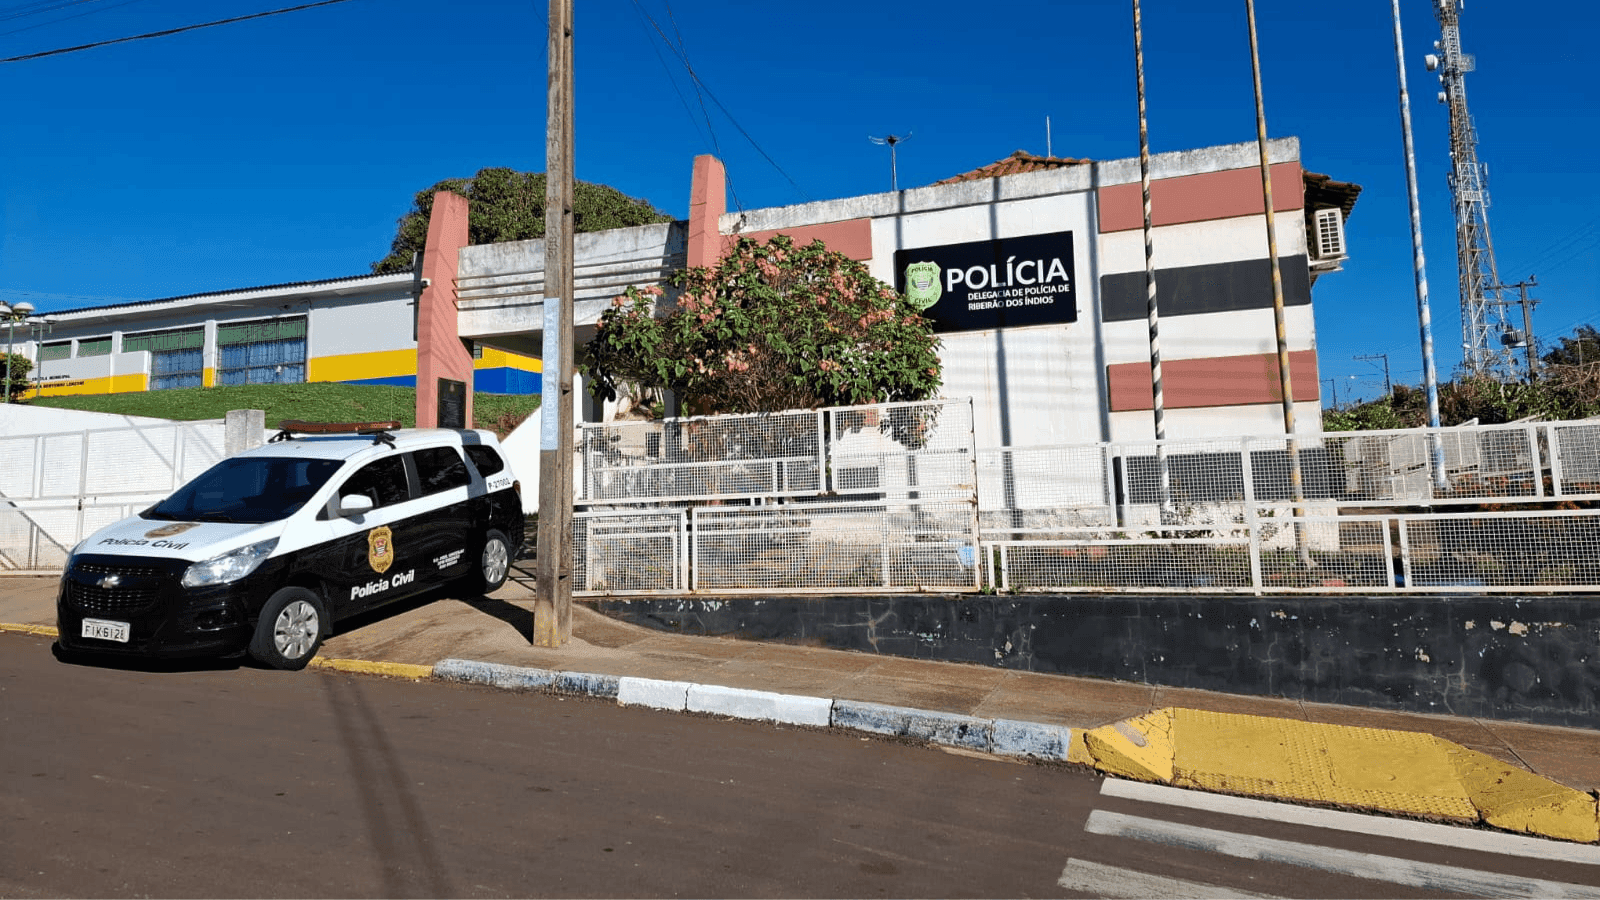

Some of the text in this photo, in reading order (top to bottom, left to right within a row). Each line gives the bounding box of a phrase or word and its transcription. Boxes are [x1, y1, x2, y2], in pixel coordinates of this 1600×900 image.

[946, 255, 1069, 292] POLÍCIA
[968, 284, 1070, 301] DELEGACIA DE POLÍCIA DE
[968, 295, 1054, 311] RIBEIRÃO DOS ÍNDIOS
[151, 540, 190, 550] Civil
[350, 569, 415, 601] Polícia Civil
